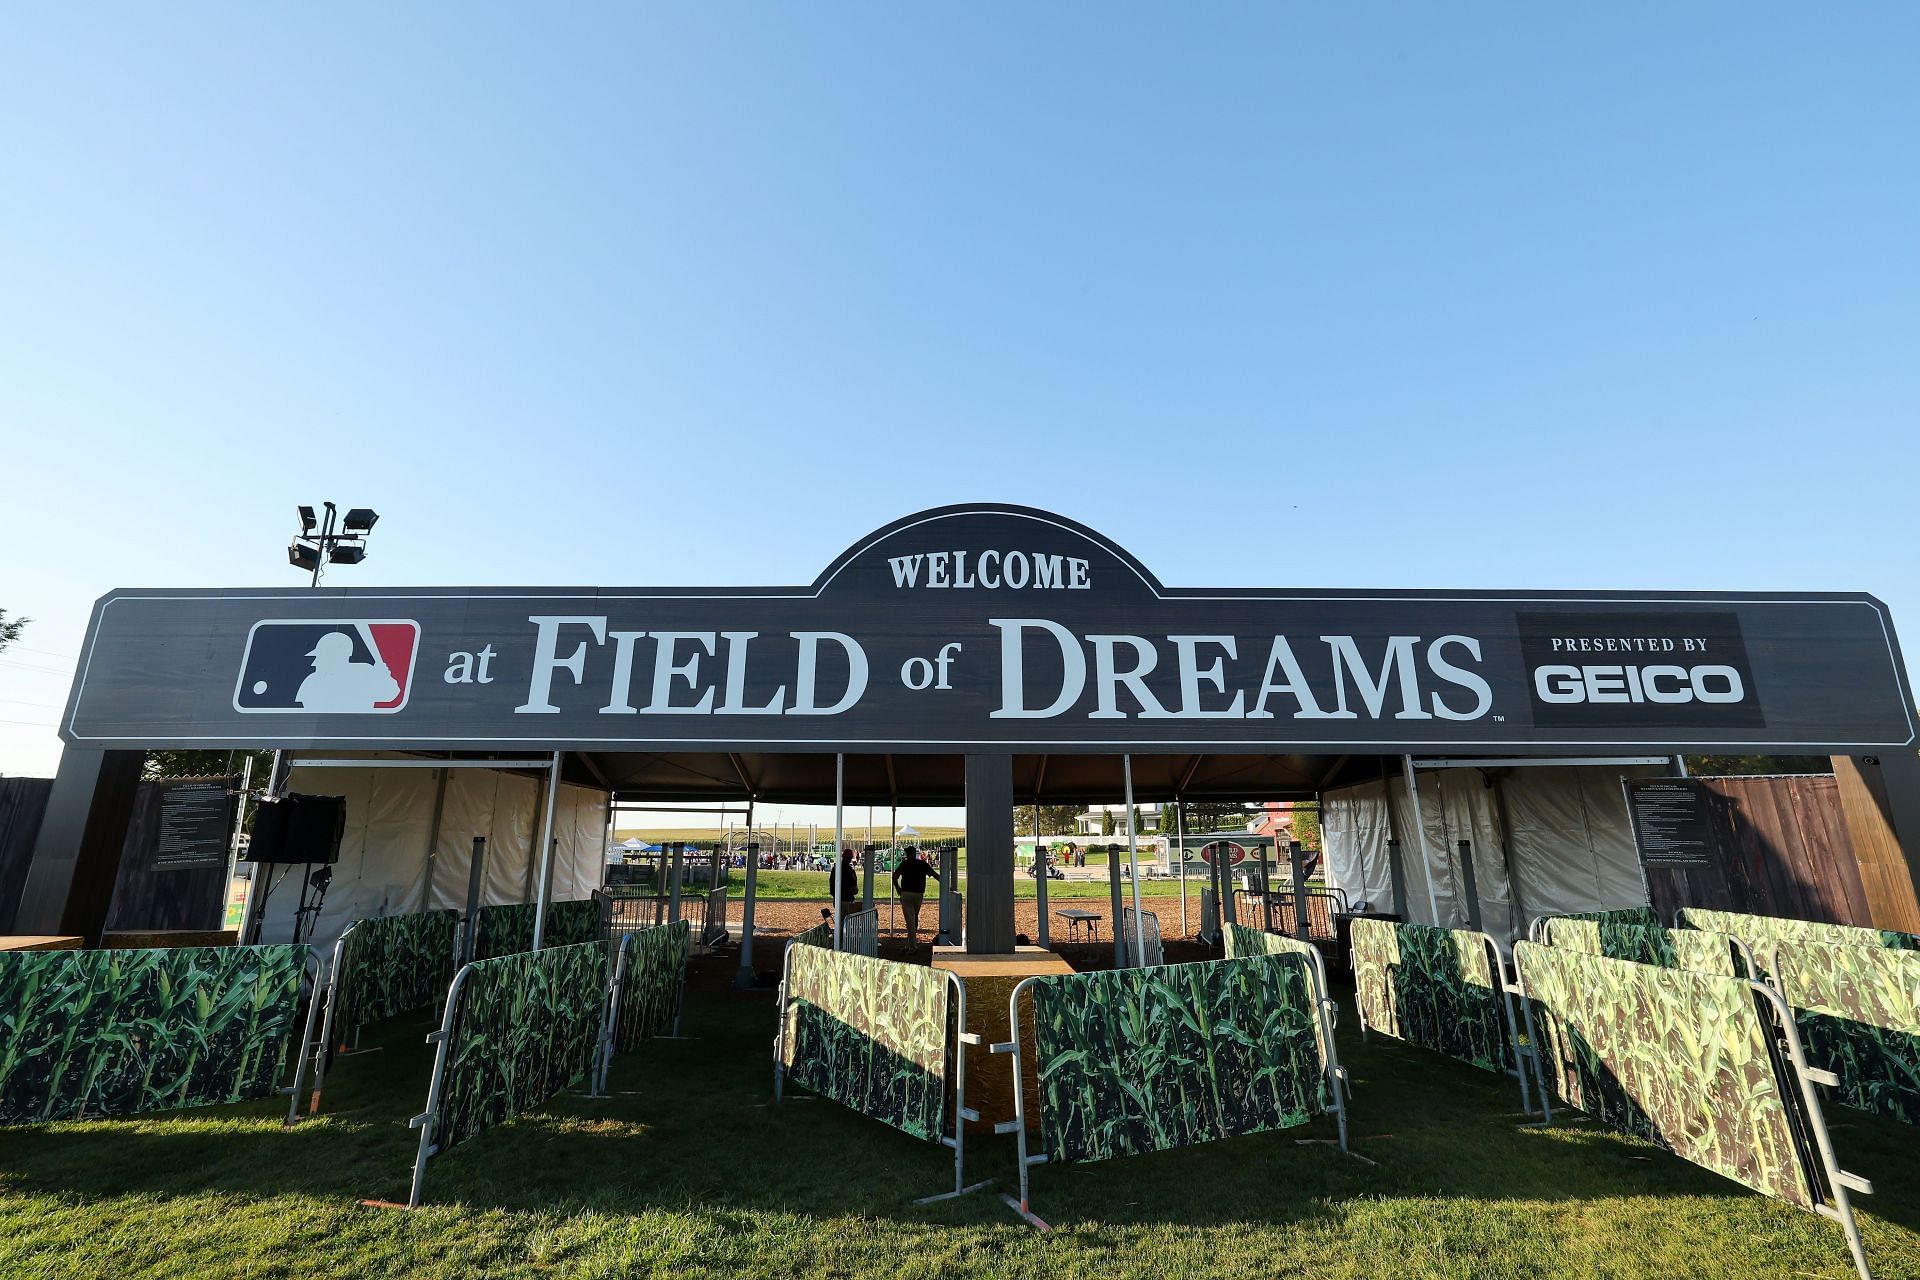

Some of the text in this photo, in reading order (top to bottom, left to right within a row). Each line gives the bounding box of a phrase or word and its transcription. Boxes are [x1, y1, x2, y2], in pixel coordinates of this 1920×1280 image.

[887, 549, 1092, 590] WELCOME
[1551, 637, 1708, 653] PRESENTED BY
[443, 642, 498, 685] at
[514, 615, 870, 715] FIELD
[900, 642, 962, 691] of
[988, 617, 1494, 722] DREAMS
[1534, 664, 1745, 704] GEICO
